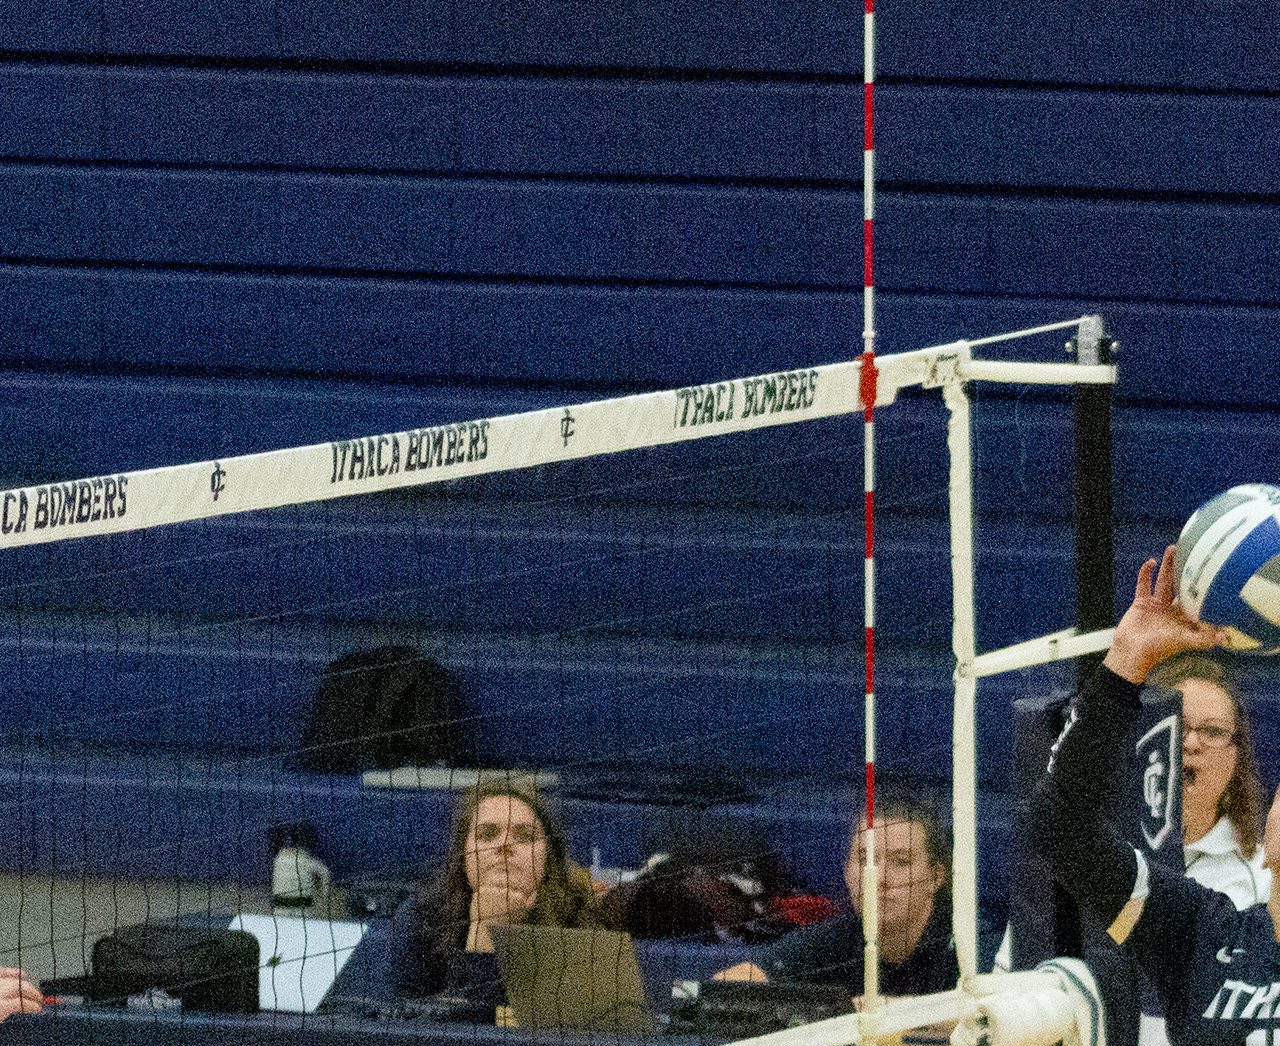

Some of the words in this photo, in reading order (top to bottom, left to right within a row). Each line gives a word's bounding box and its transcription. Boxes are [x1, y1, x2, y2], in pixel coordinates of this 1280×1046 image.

[741, 369, 819, 418] BOMBERS
[330, 437, 402, 483] ITHACA
[406, 420, 490, 471] BOMBERS
[34, 476, 128, 527] BOMBERS
